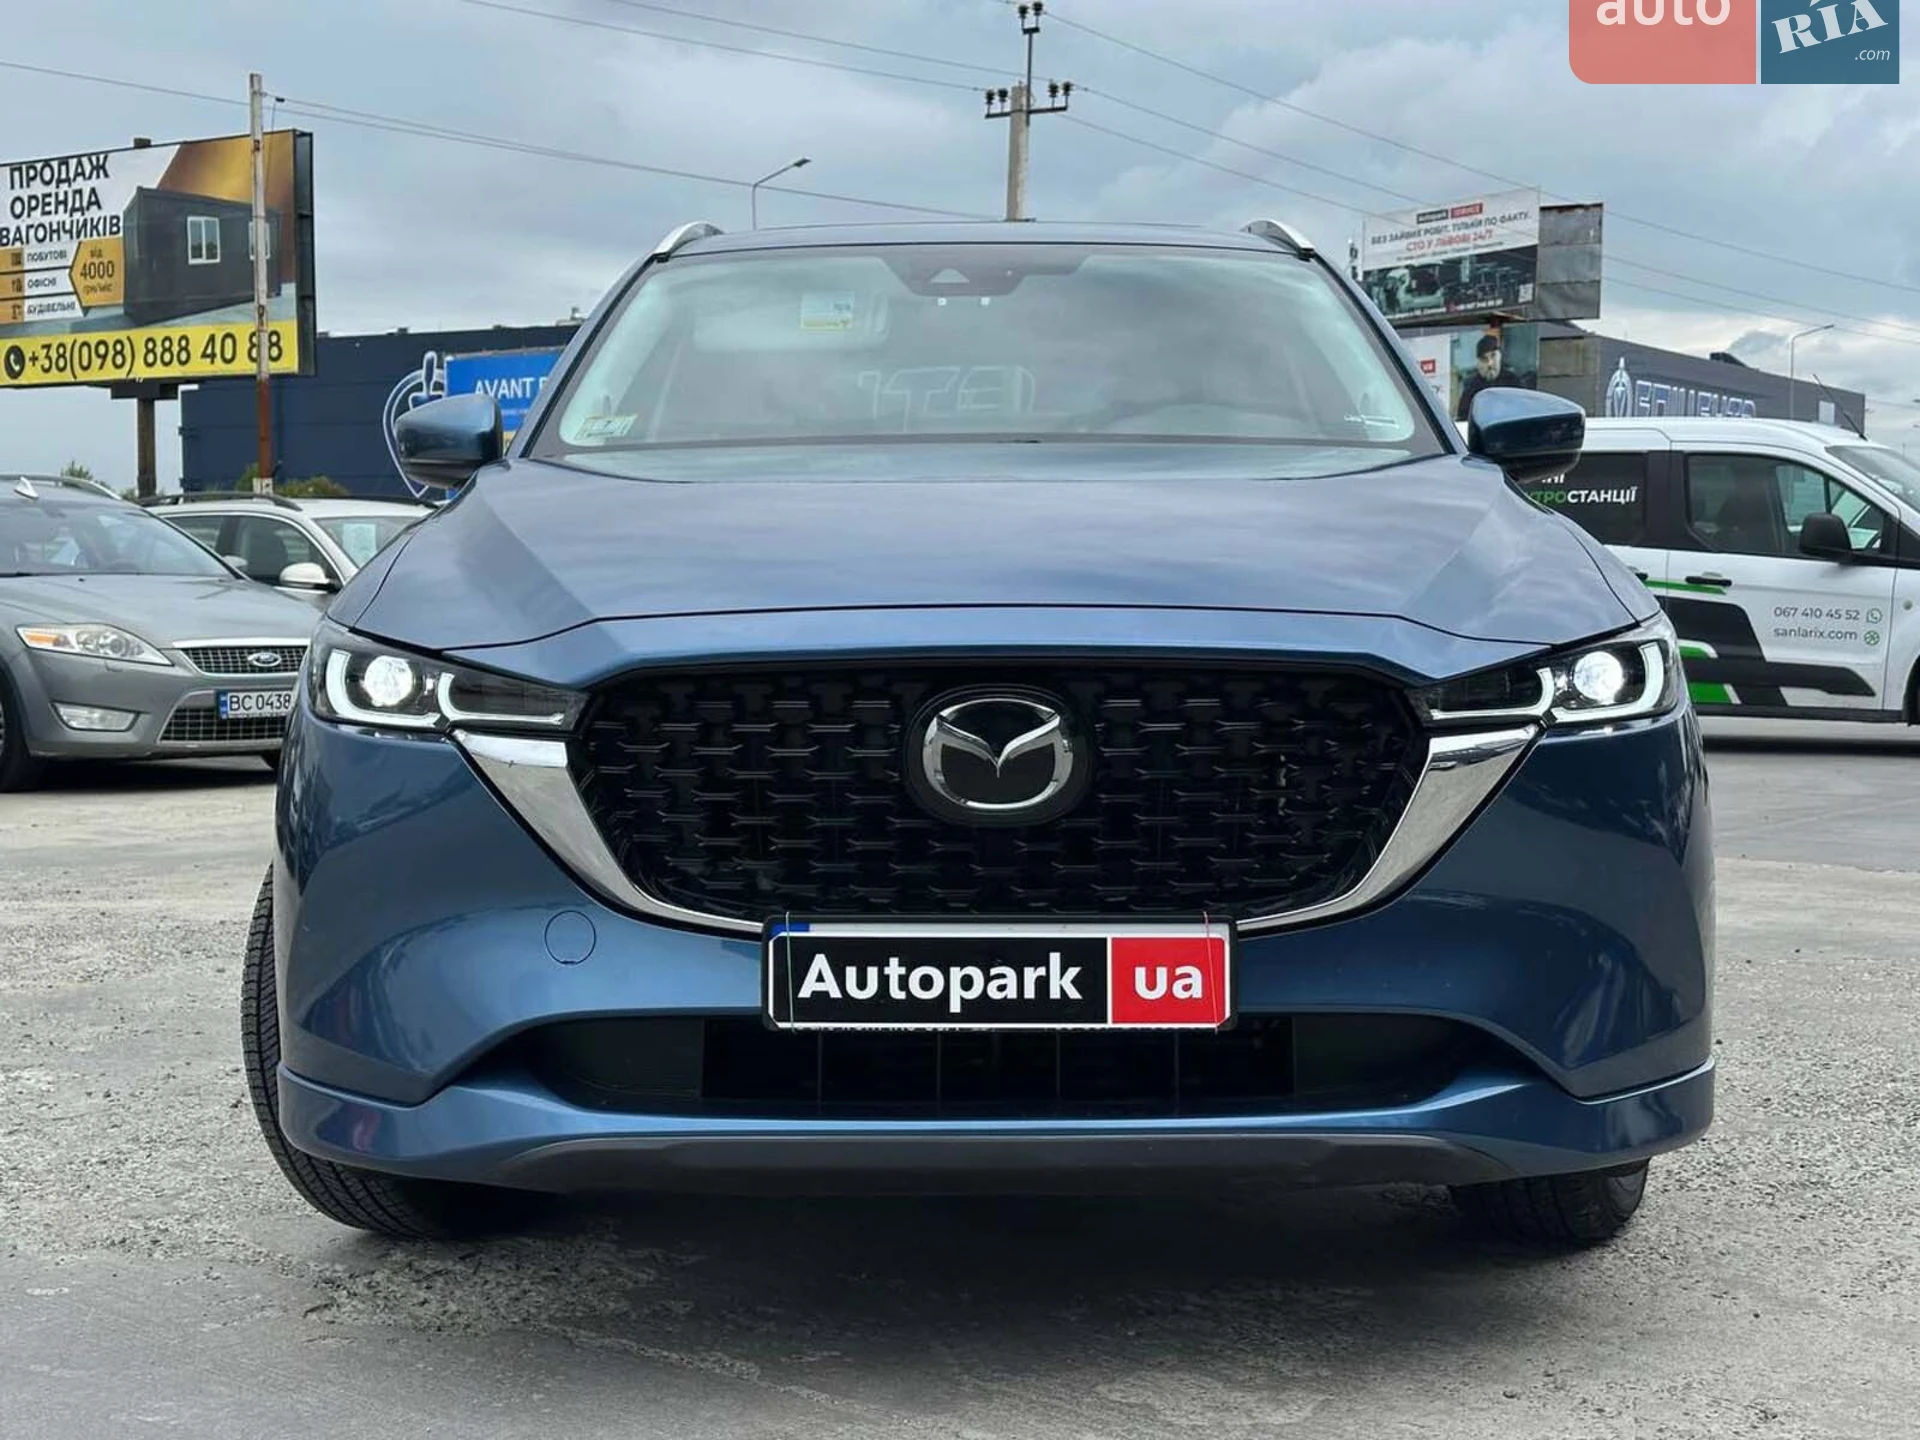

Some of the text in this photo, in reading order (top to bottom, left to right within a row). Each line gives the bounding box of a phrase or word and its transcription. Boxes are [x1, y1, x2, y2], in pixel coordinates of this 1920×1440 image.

[10, 155, 109, 190] ПРОДАЖ
[10, 187, 102, 219] ОРЕНДА
[1484, 216, 1498, 227] ПО
[0, 215, 121, 247] ВАГОНЧИКІВ
[1406, 240, 1426, 252] СТО
[1426, 239, 1434, 250] У
[27, 249, 68, 262] ПОБУТОВІ
[80, 260, 115, 280] 4000
[27, 278, 57, 288] ОФІСНІ
[27, 301, 76, 315] БУДІВЕЛЬНІ
[29, 330, 283, 380] +38(098) 888 40 88
[475, 377, 535, 399] AVANT
[1774, 606, 1860, 620] 067 410 45 52
[1774, 627, 1858, 640] sanlarix.com
[229, 693, 291, 711] BC 0438
[797, 951, 1204, 1013] Autopark ua
